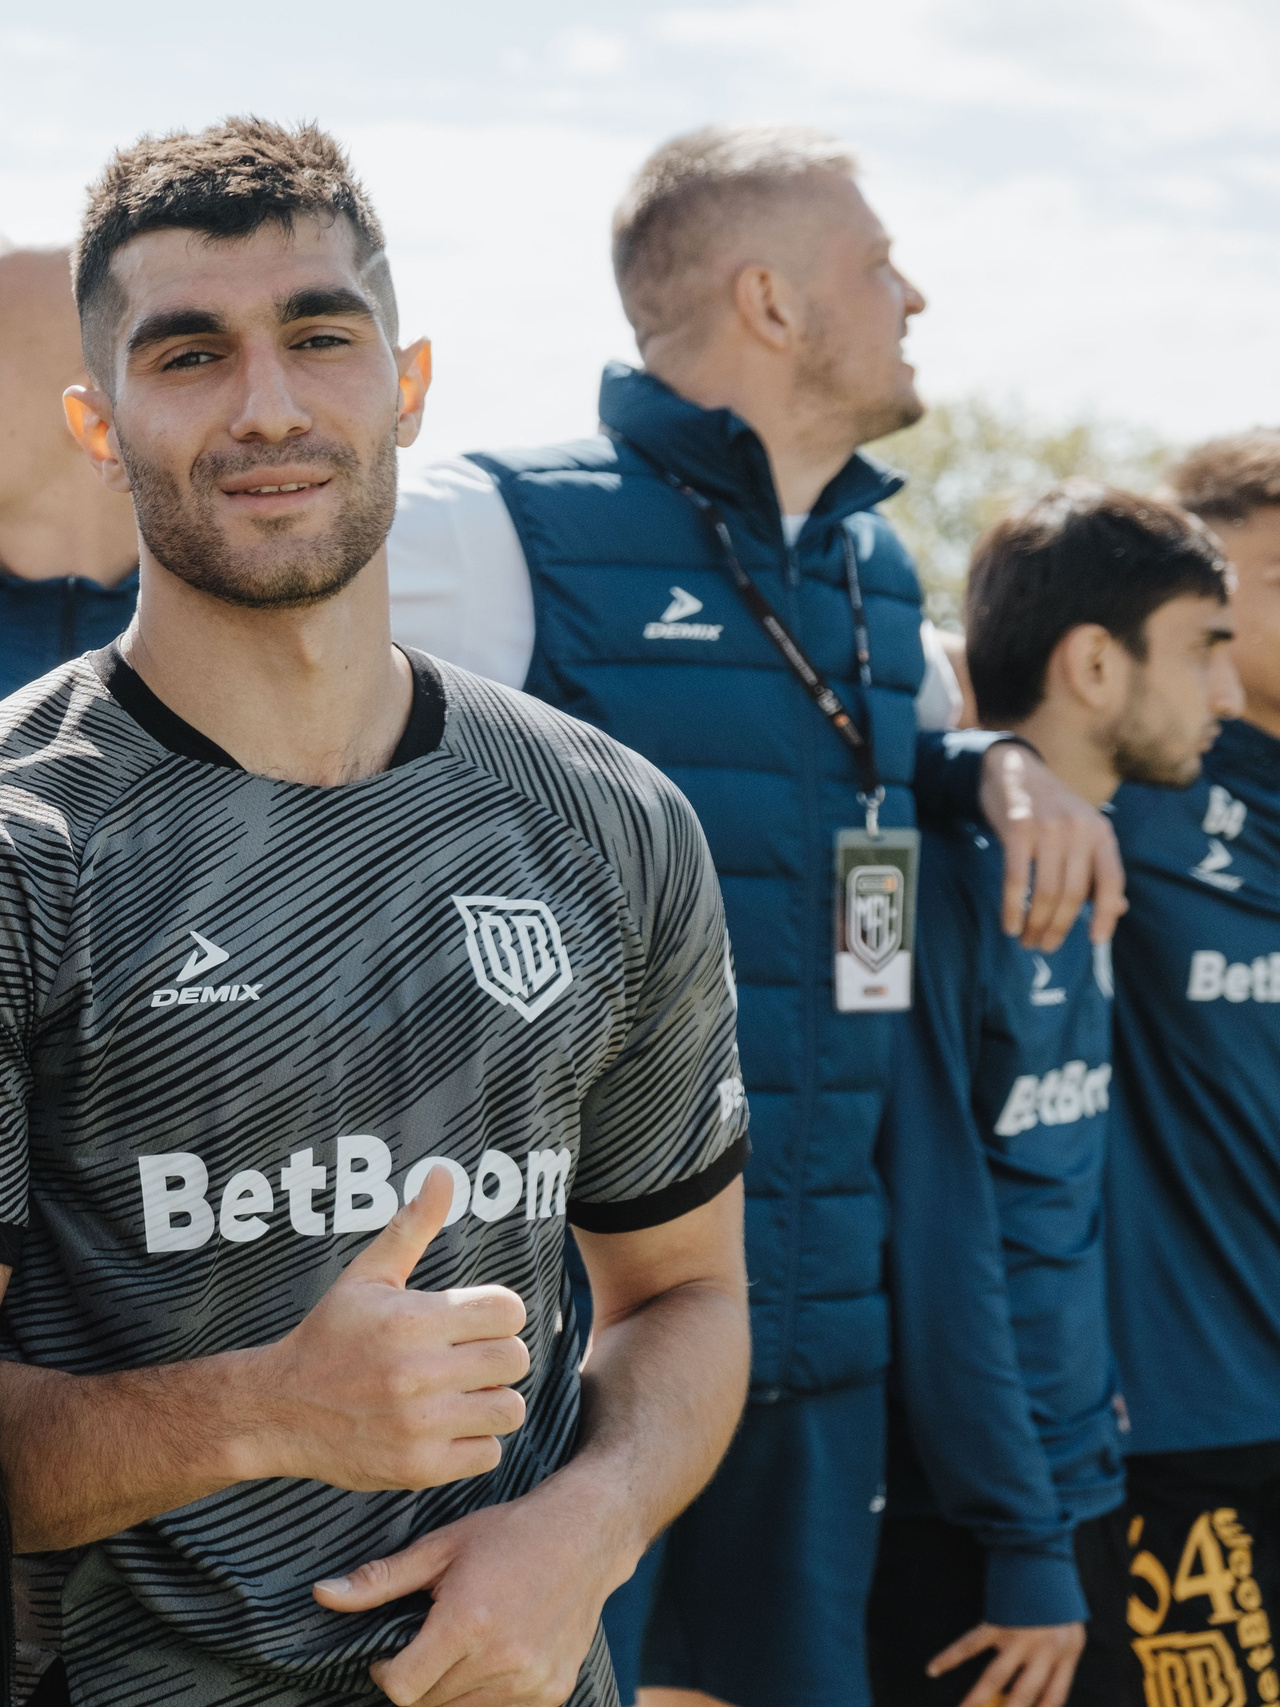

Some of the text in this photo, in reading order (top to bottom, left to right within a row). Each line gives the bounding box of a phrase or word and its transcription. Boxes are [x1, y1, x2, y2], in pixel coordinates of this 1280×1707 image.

[643, 622, 724, 641] DEMIX
[150, 983, 264, 1008] DEMIX
[138, 1134, 572, 1254] BetBoom
